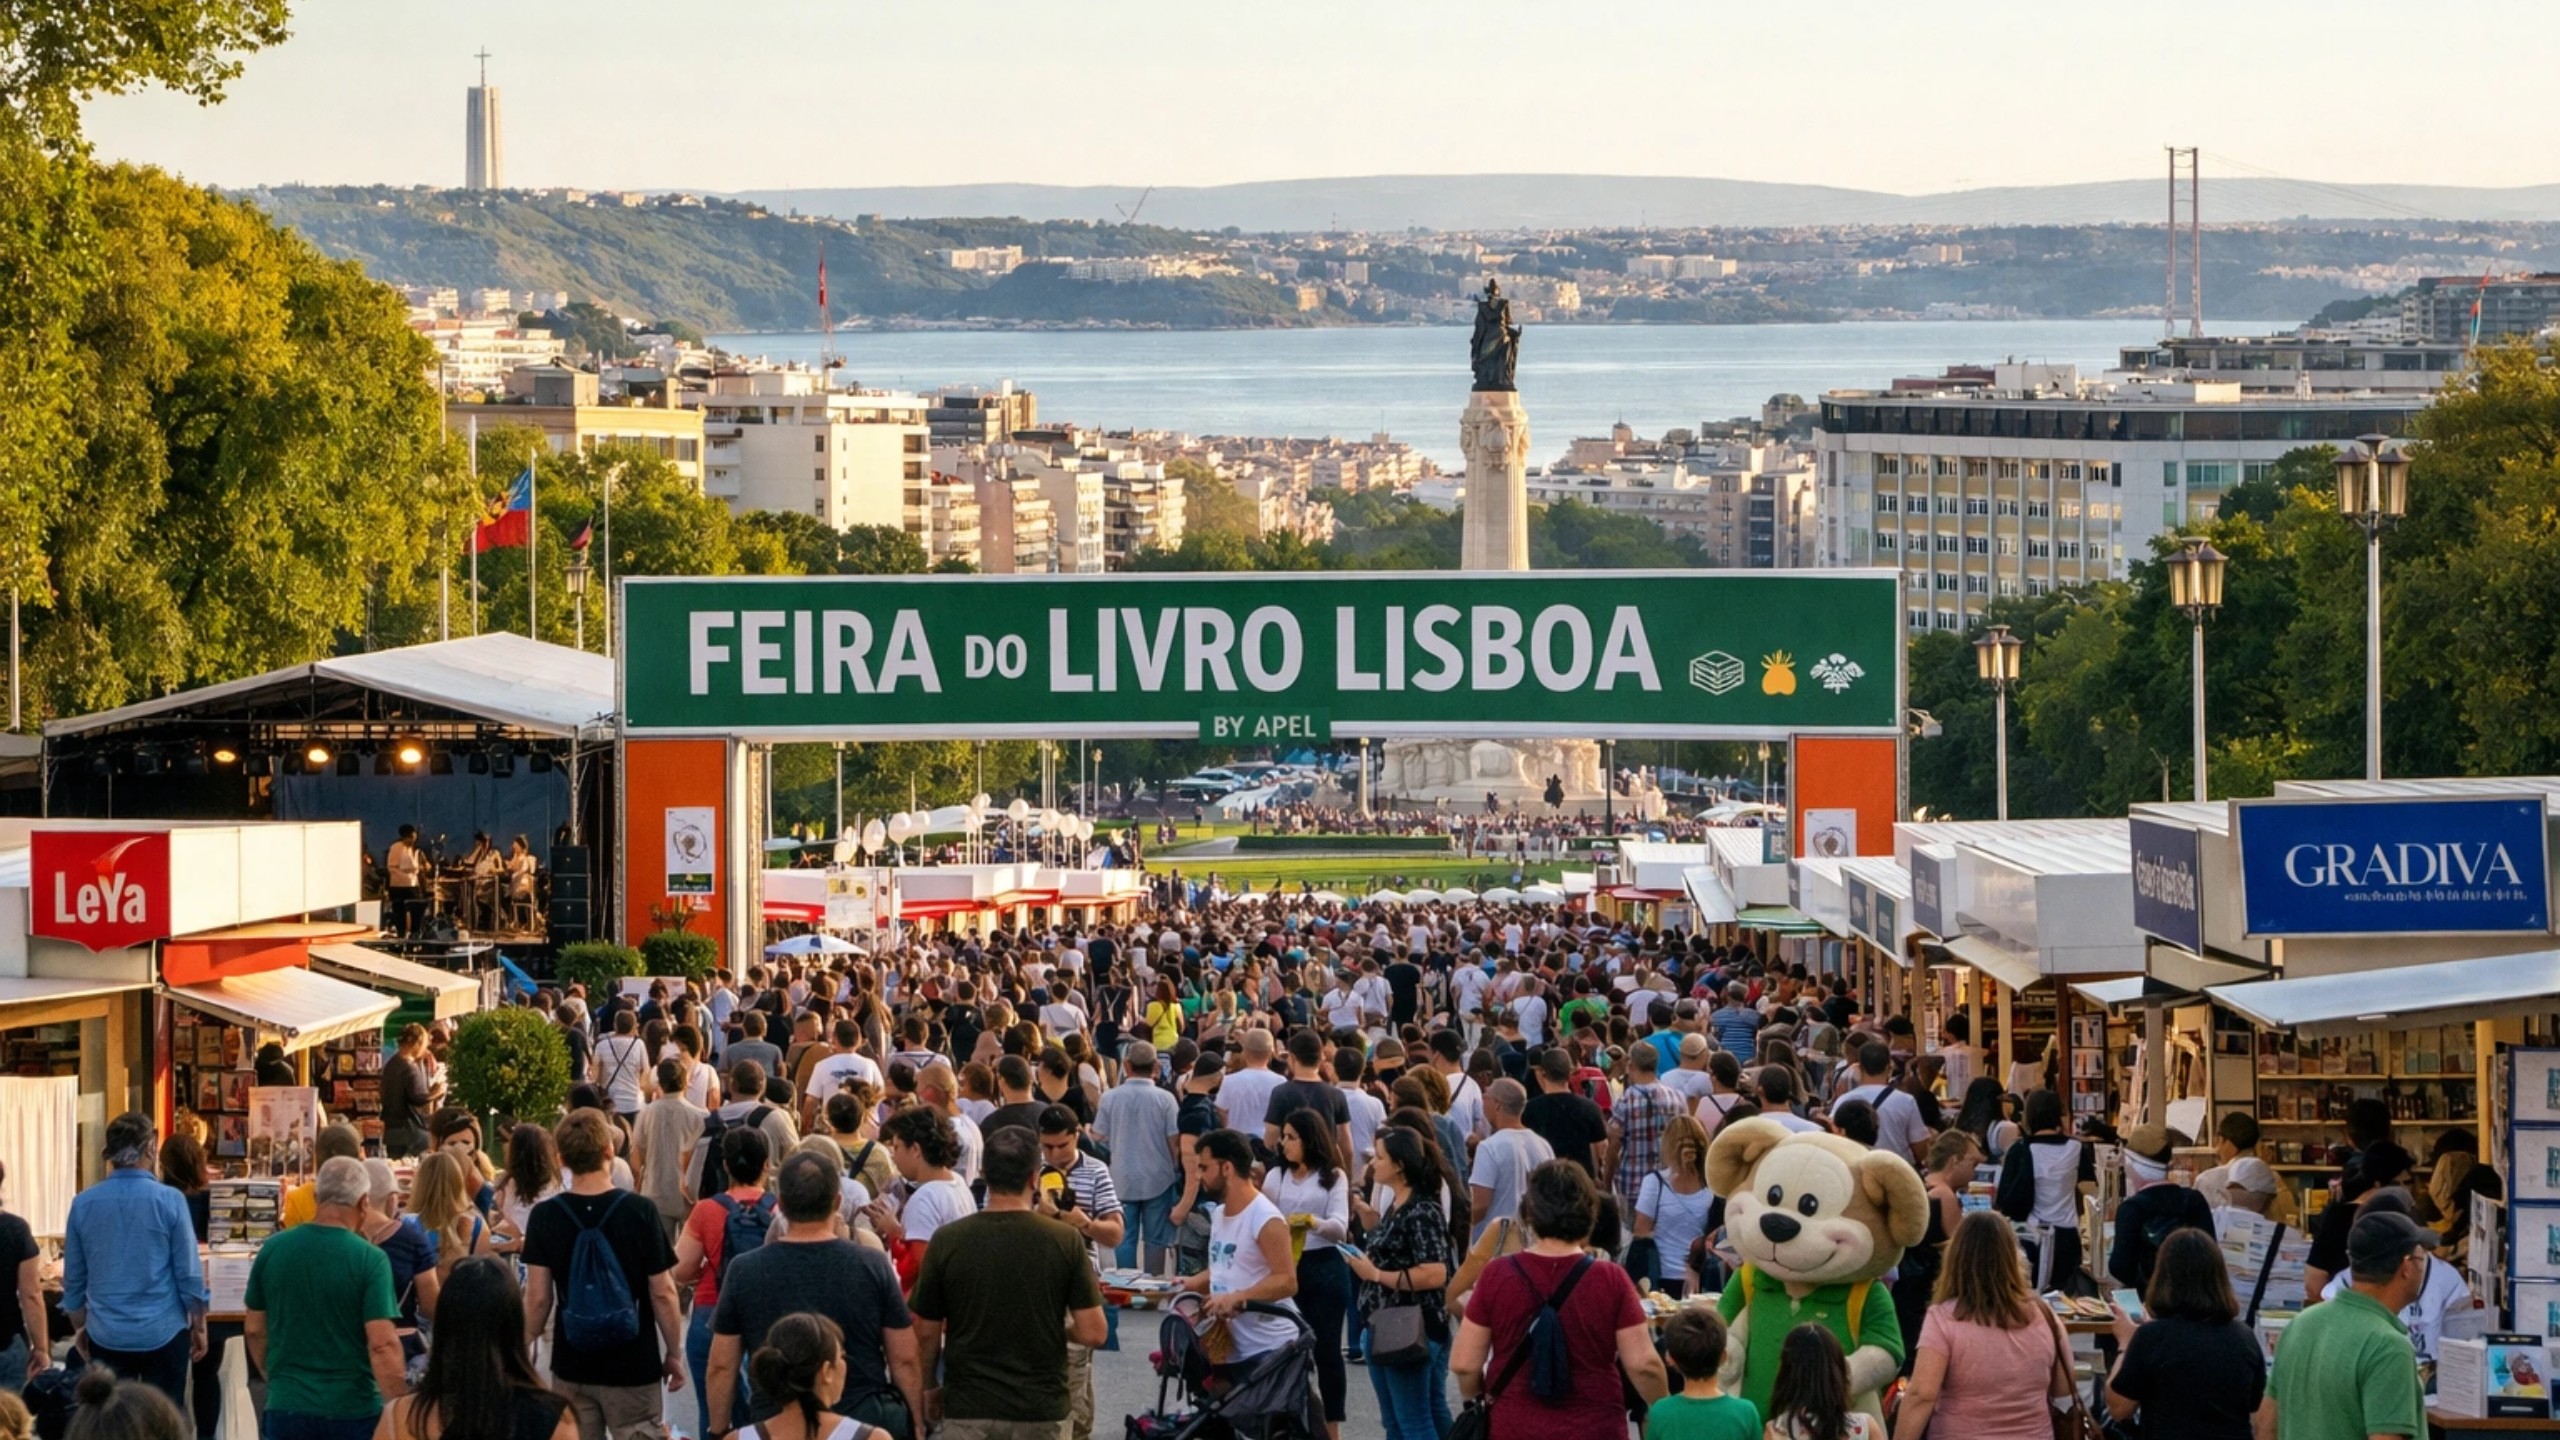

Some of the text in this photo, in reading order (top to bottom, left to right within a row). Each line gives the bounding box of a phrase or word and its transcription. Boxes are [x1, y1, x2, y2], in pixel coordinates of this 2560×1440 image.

[688, 604, 1663, 696] FEIRA DO LIVRO LISBOA
[1213, 715, 1317, 738] BY APEL
[2284, 842, 2523, 888] GRADIVA
[54, 871, 147, 925] LeYa
